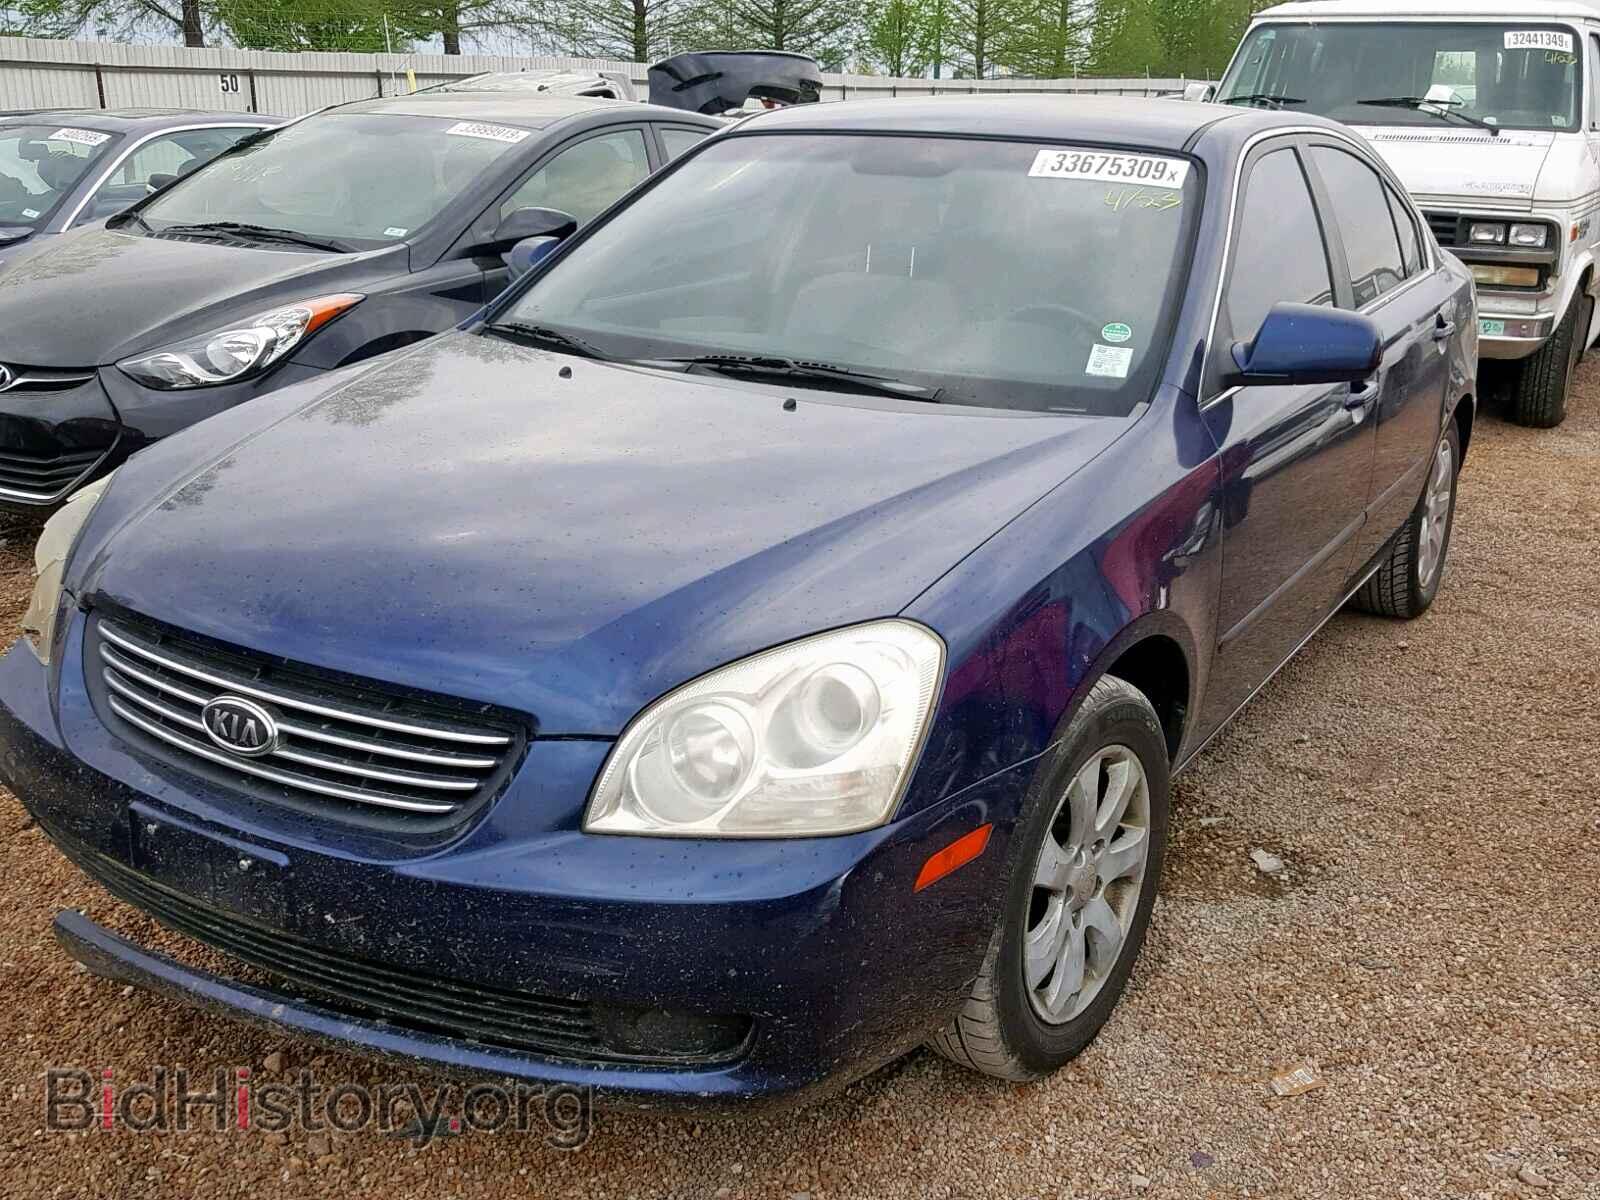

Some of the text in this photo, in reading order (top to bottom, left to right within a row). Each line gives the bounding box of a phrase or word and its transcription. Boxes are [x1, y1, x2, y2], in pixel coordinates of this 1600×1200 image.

[220, 73, 239, 92] 50
[1104, 186, 1184, 213] 4/23
[212, 707, 260, 746] KIA
